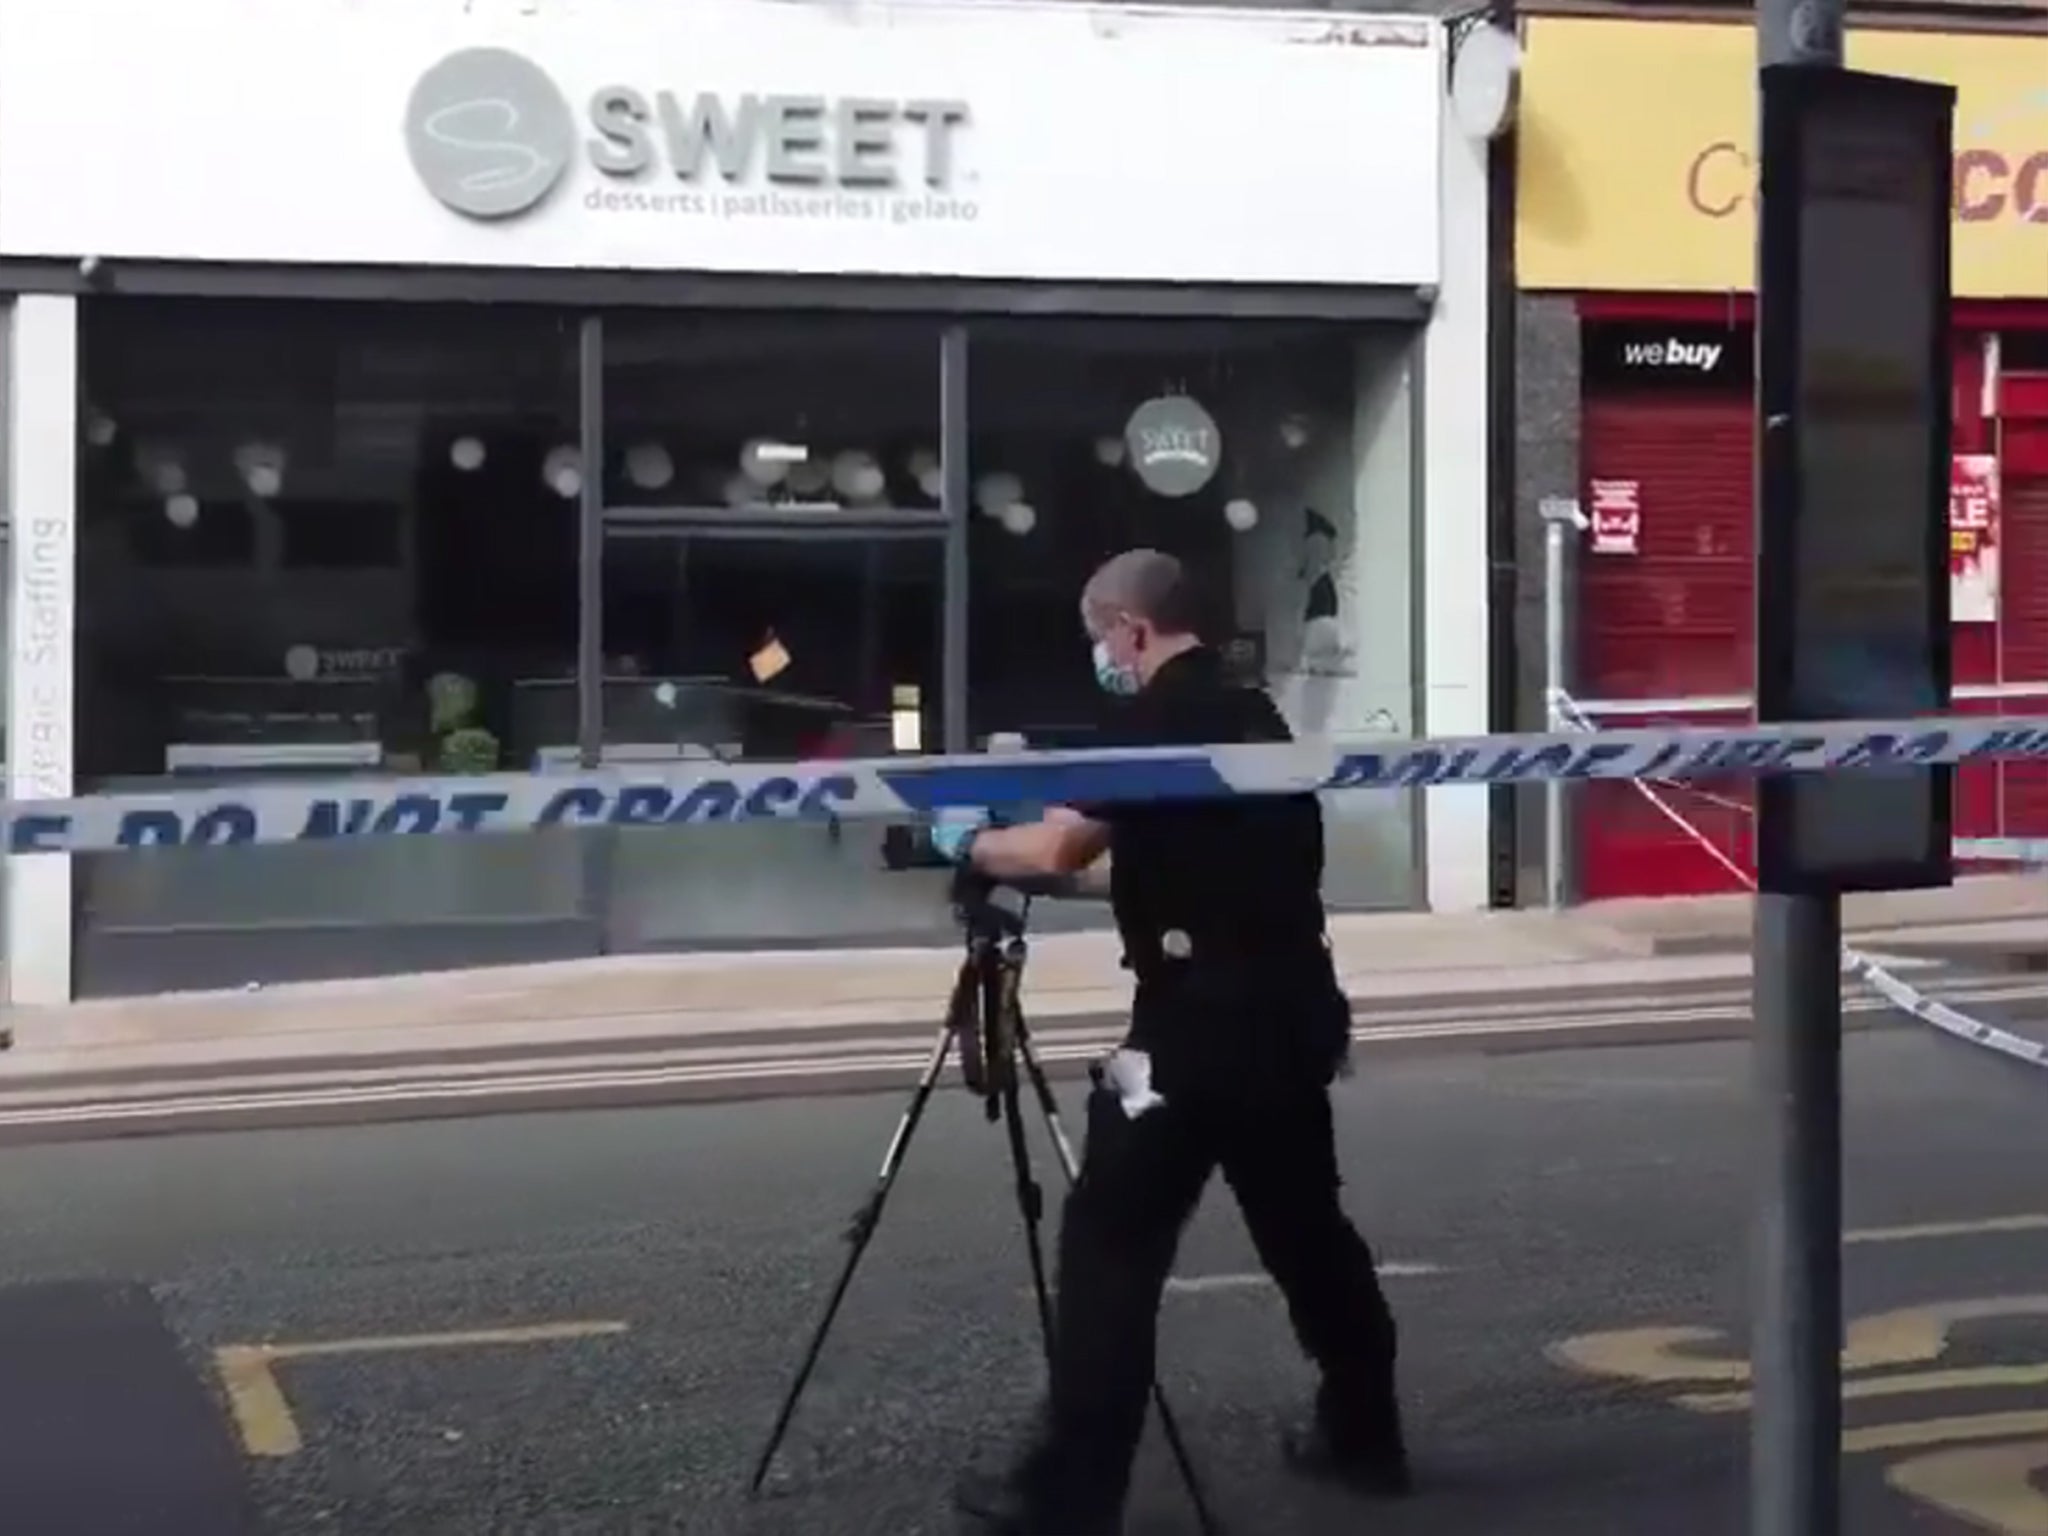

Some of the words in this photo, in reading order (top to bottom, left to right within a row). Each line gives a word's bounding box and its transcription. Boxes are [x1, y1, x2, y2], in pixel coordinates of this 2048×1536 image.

[585, 84, 972, 190] SWEET
[584, 186, 705, 215] desserts
[723, 192, 873, 222] patisseries
[891, 195, 980, 224] gelato
[1950, 497, 1989, 528] LE
